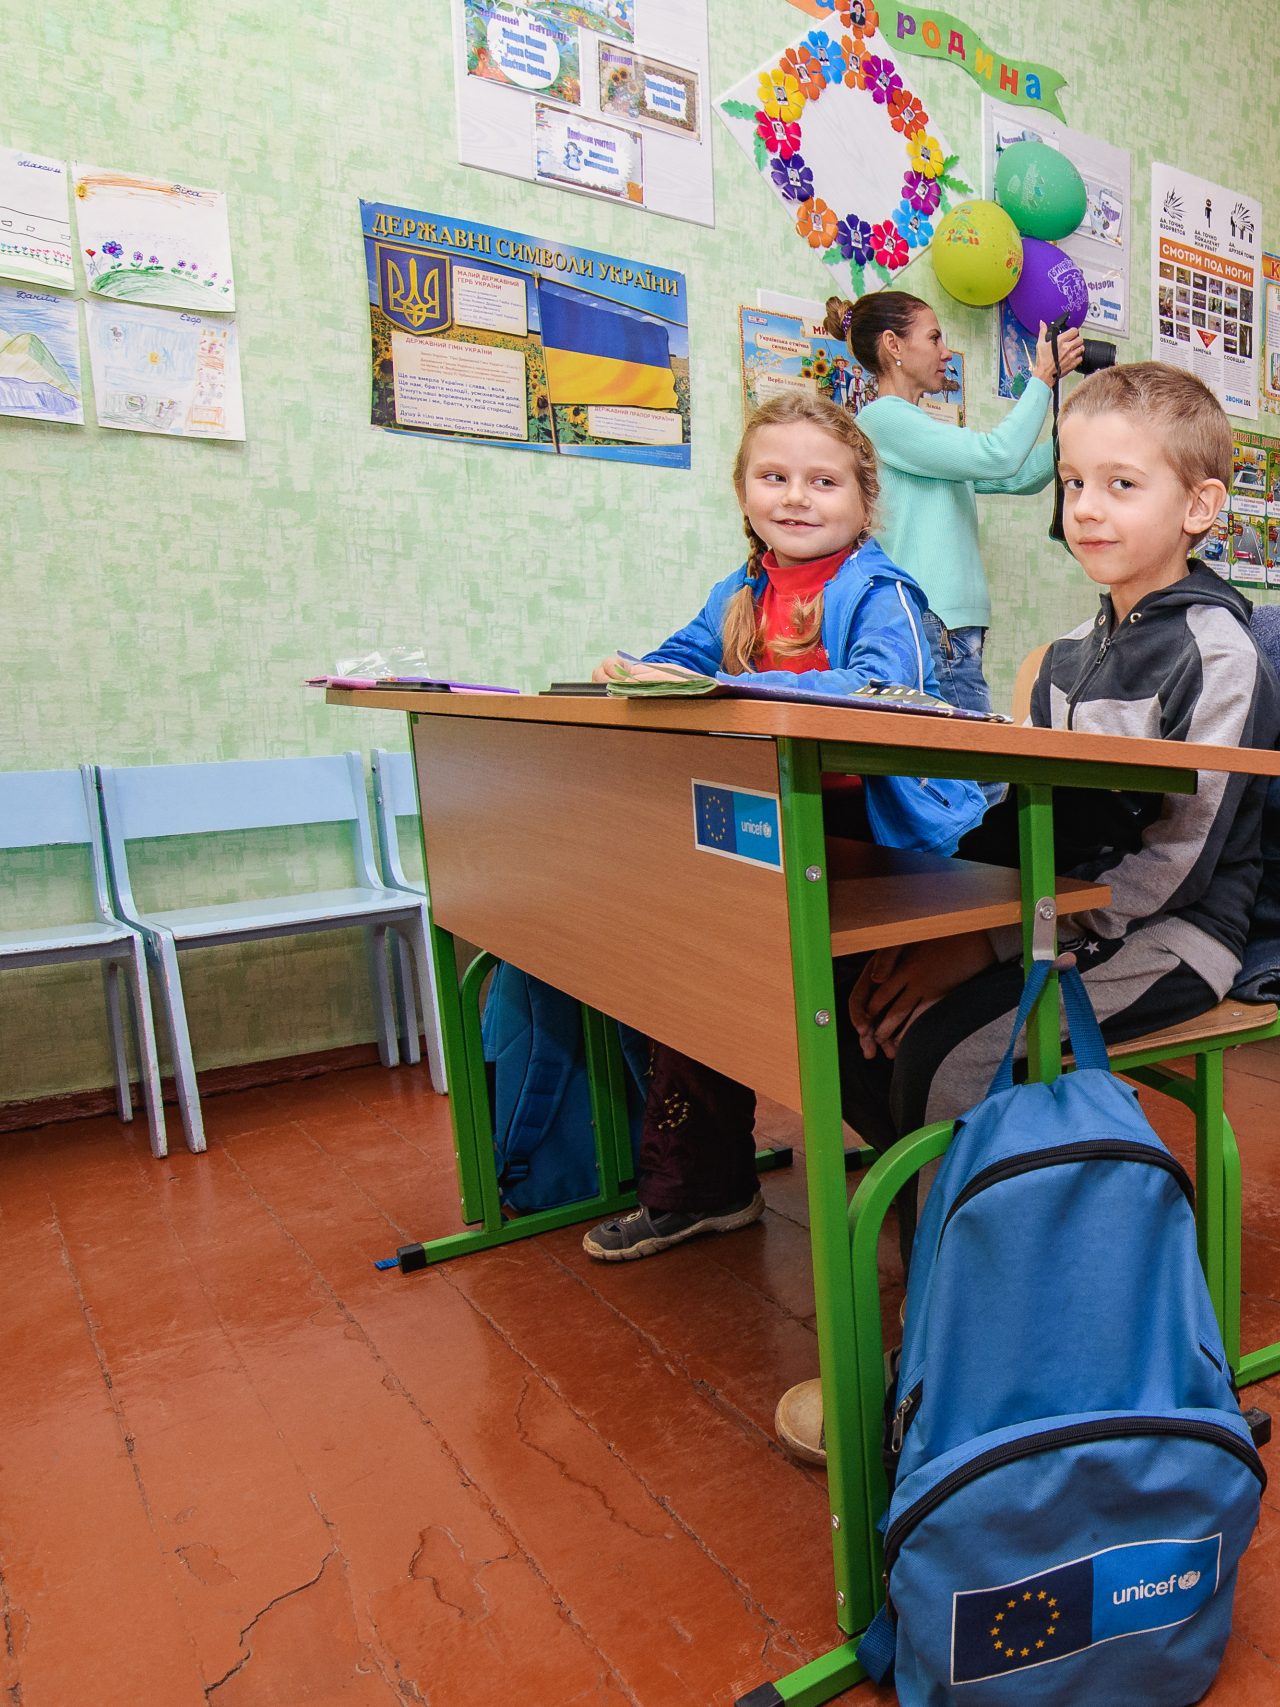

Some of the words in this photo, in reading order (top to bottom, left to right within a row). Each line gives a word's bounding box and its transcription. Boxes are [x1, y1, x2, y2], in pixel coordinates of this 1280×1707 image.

[372, 212, 491, 254] ДЕРЖАВНІ
[495, 238, 594, 278] СИМВОЛИ
[598, 261, 679, 297] УКРАЇНИ
[1162, 244, 1202, 265] СМОТРИ
[1204, 258, 1223, 273] ПОД
[1225, 265, 1251, 282] НОГИ!
[475, 281, 501, 290] УКРАЇНИ
[482, 275, 519, 287] ДЕРЖАВНИЙ
[406, 337, 447, 348] ДЕРЖАВНИЙ
[465, 346, 493, 356] УКРАЇНИ
[595, 406, 629, 415] ДЕРЖАВНИЙ
[652, 414, 674, 422] УКРАЇНИ
[741, 819, 763, 836] unicef
[1113, 1574, 1177, 1605] unicef
